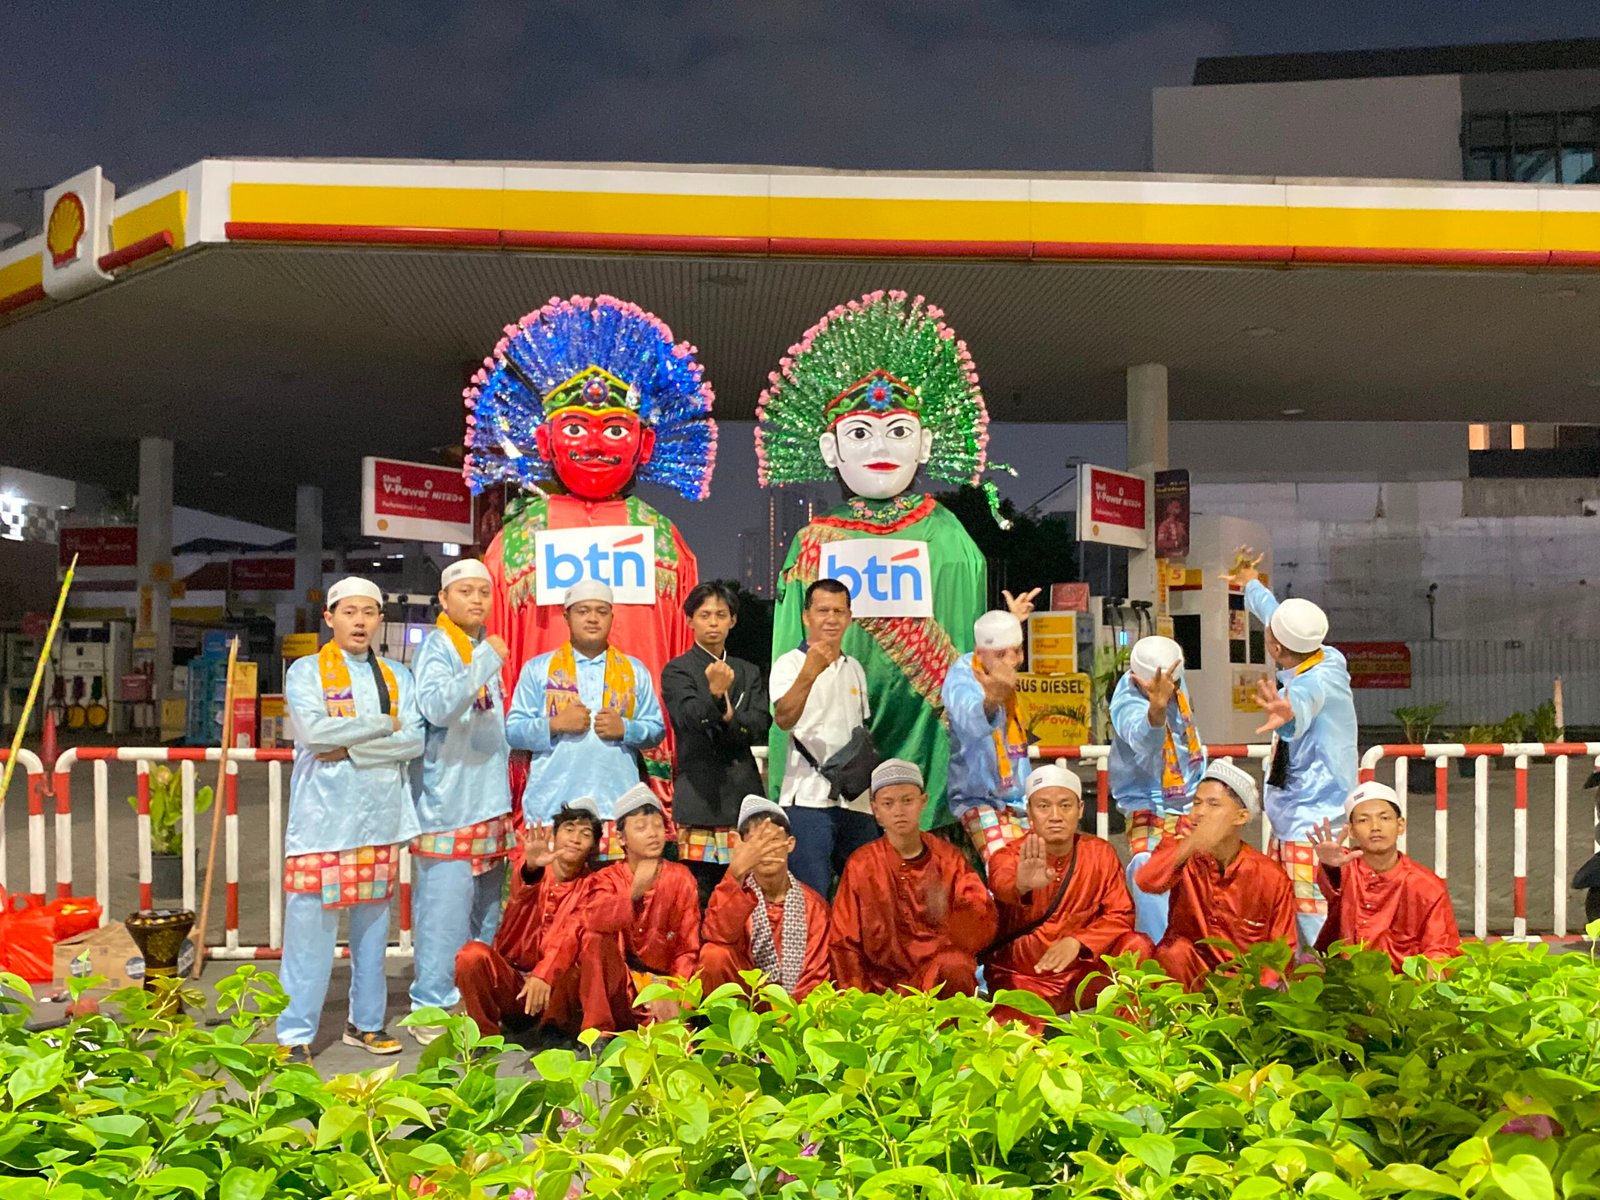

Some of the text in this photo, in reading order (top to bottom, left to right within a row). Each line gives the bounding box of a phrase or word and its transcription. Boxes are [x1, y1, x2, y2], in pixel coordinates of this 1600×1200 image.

[383, 474, 401, 483] Shell
[383, 483, 429, 499] V-Power
[1095, 490, 1123, 505] V-Power
[545, 534, 646, 589] btn
[828, 548, 922, 602] btn
[1171, 569, 1182, 580] 5
[1041, 680, 1084, 694] DIESEL
